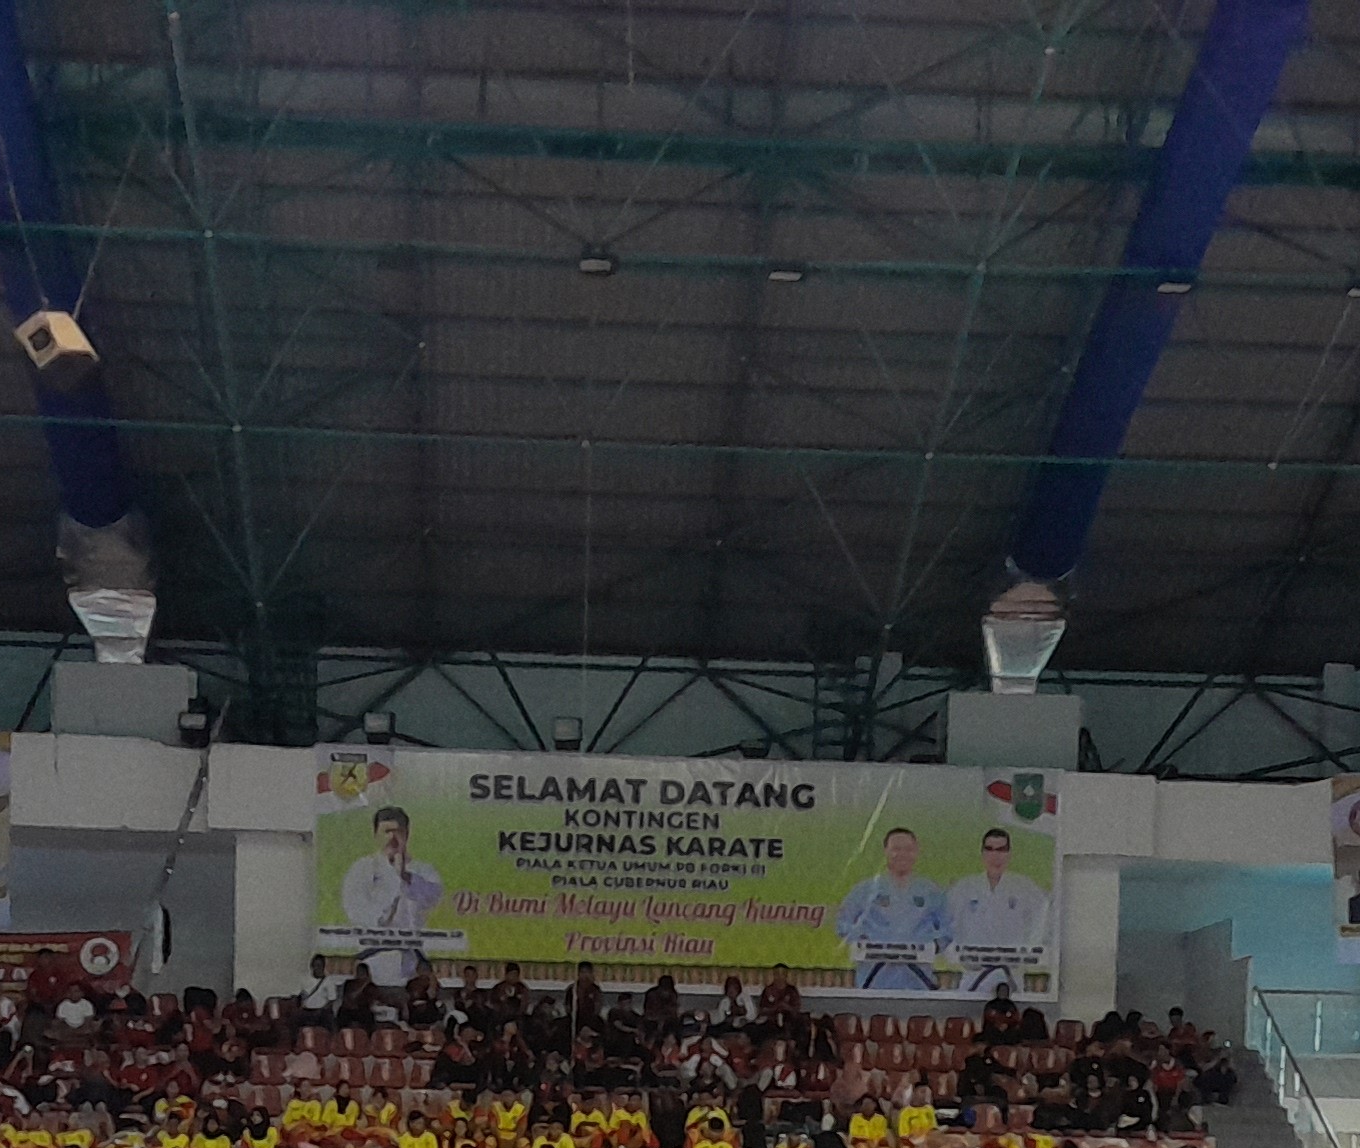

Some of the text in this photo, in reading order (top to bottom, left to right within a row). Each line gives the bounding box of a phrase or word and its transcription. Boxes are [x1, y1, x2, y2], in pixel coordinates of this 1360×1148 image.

[469, 773, 816, 809] SELAMAT DATANG
[564, 808, 720, 831] KONTINGEN
[498, 830, 784, 859] KEJURNAS KARATE
[516, 857, 562, 869] PIALA
[568, 859, 618, 871] KETUA
[623, 860, 671, 872] UMUM
[551, 875, 729, 890] PIALA GUBERNUR RIAU
[453, 890, 825, 929] Di Bumi Melayu Lancang Kuning
[564, 931, 715, 956] Provinsi Riau
